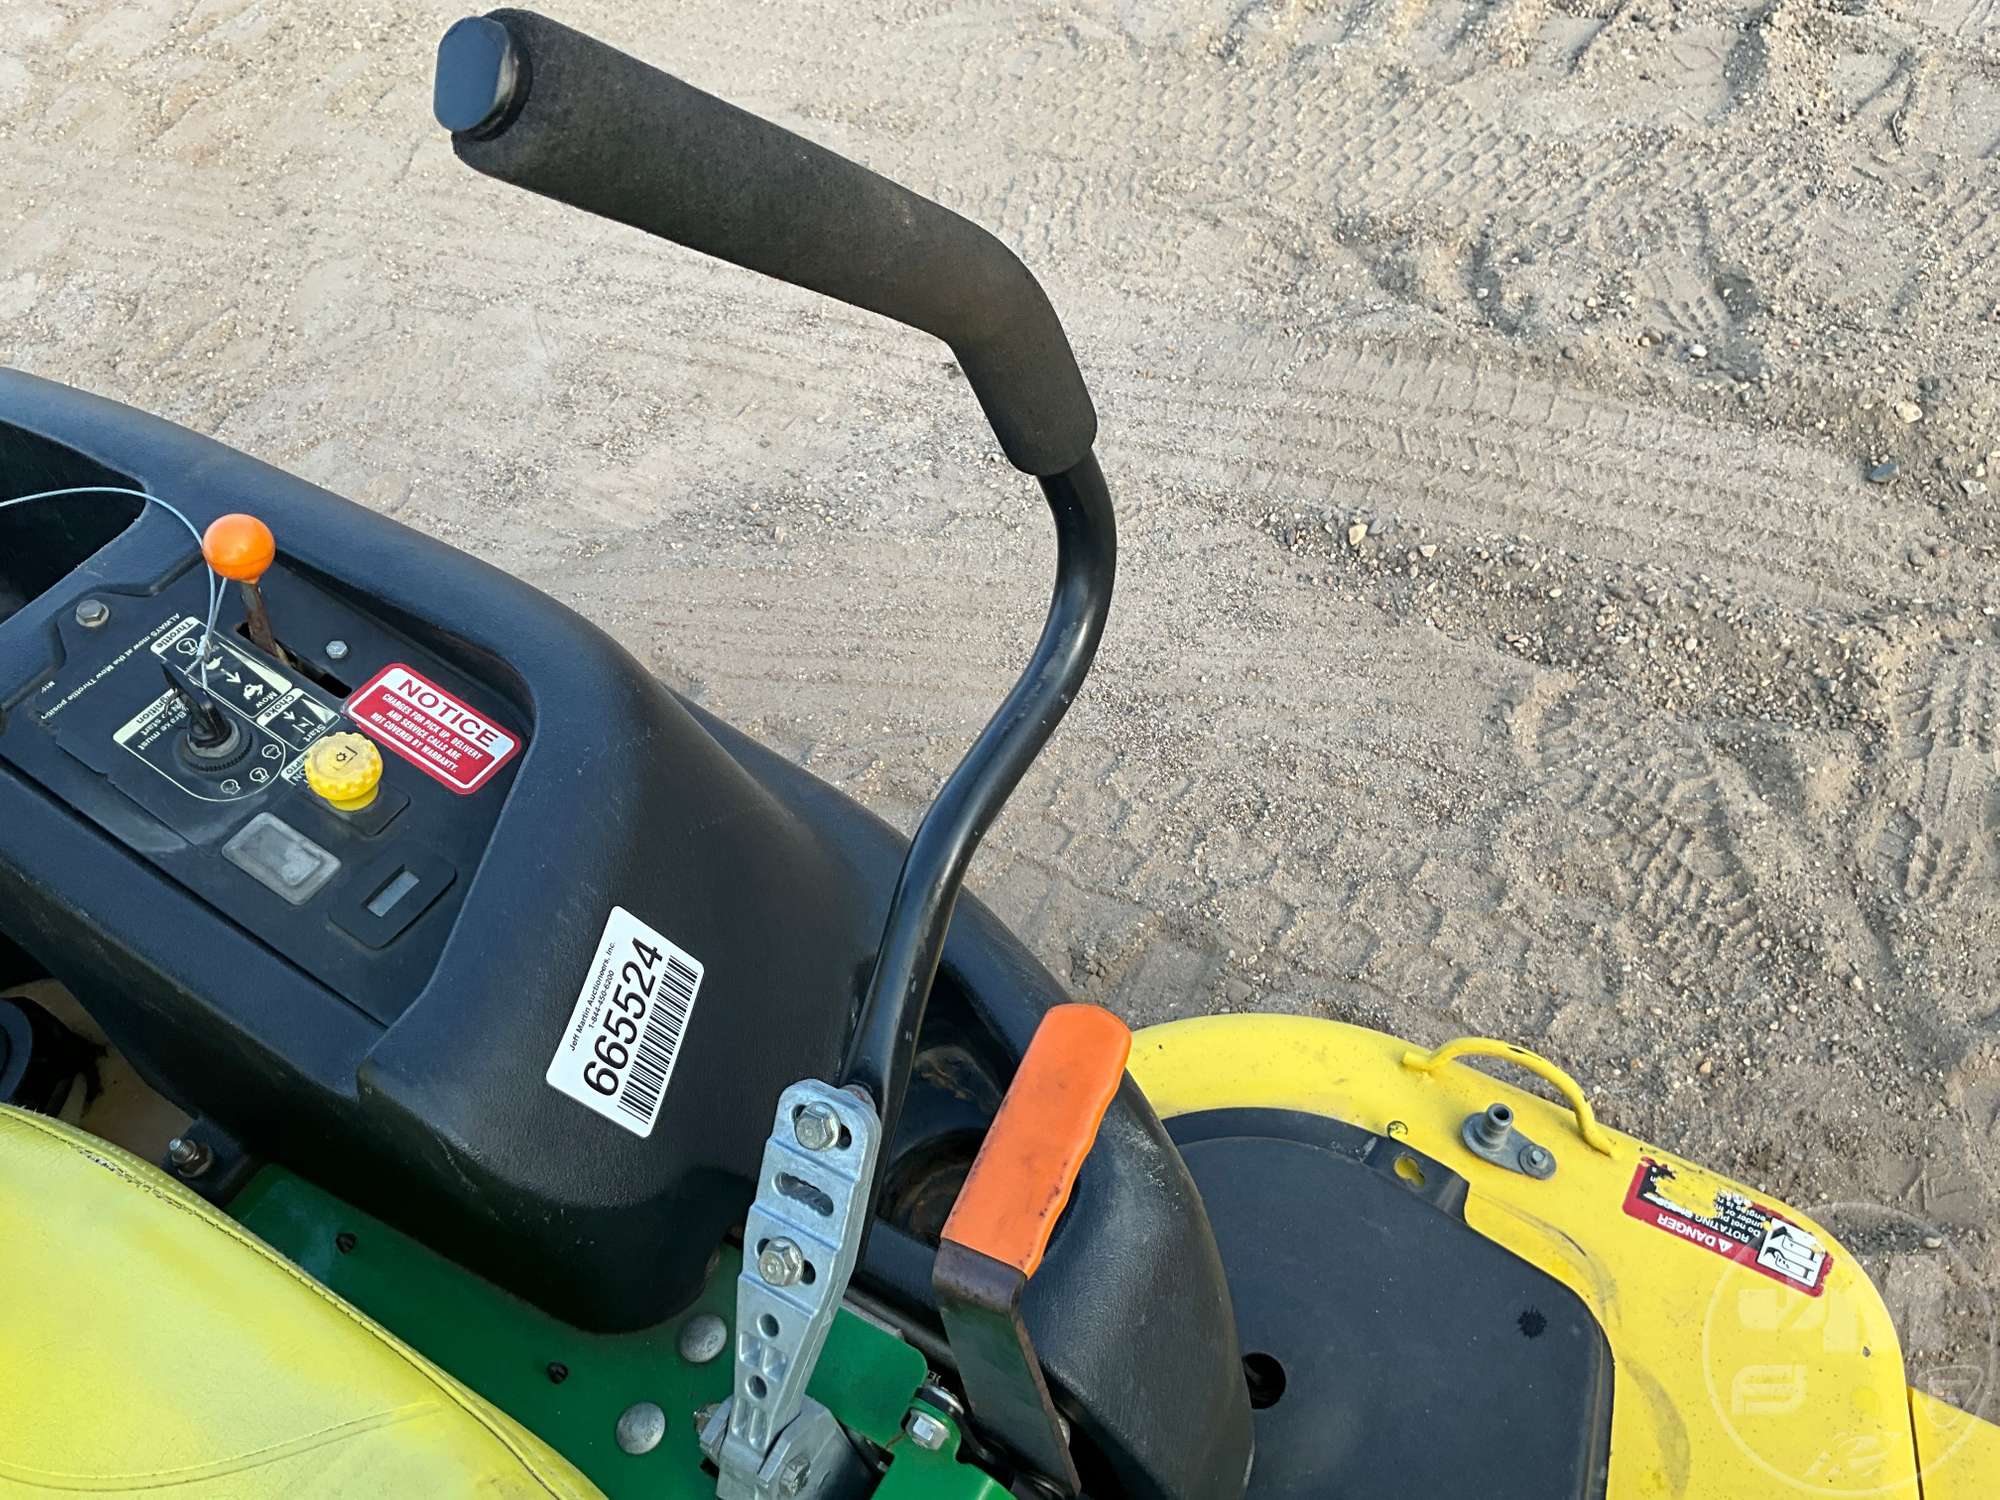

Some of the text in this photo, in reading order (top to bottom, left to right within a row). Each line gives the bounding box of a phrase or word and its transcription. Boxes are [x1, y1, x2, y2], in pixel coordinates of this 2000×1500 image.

[156, 621, 194, 648] Throttle
[255, 690, 278, 709] Mow
[265, 694, 295, 718] Choke
[397, 679, 499, 748] NOTICE
[137, 711, 187, 750] Brake must
[140, 719, 161, 736] start
[303, 723, 326, 743] Start
[370, 712, 460, 773] NOT COVERED BY WARRANTY.
[382, 693, 412, 716] CHARGES
[409, 708, 426, 724] FOR
[422, 716, 442, 735] PICK
[451, 737, 483, 761] DELIVERY
[386, 709, 462, 760] AND SERVICE CALLS ARE
[570, 942, 616, 1052] Jeff Martin Auctioneers, Inc.
[588, 969, 615, 1029] 1-844-450-6200
[583, 937, 663, 1096] 665524
[1657, 1213, 1717, 1248] DANGER
[1694, 1214, 1750, 1243] ROTATING
[1730, 1218, 1747, 1228] not
[1742, 1215, 1763, 1229] under
[1748, 1227, 1761, 1238] Do
